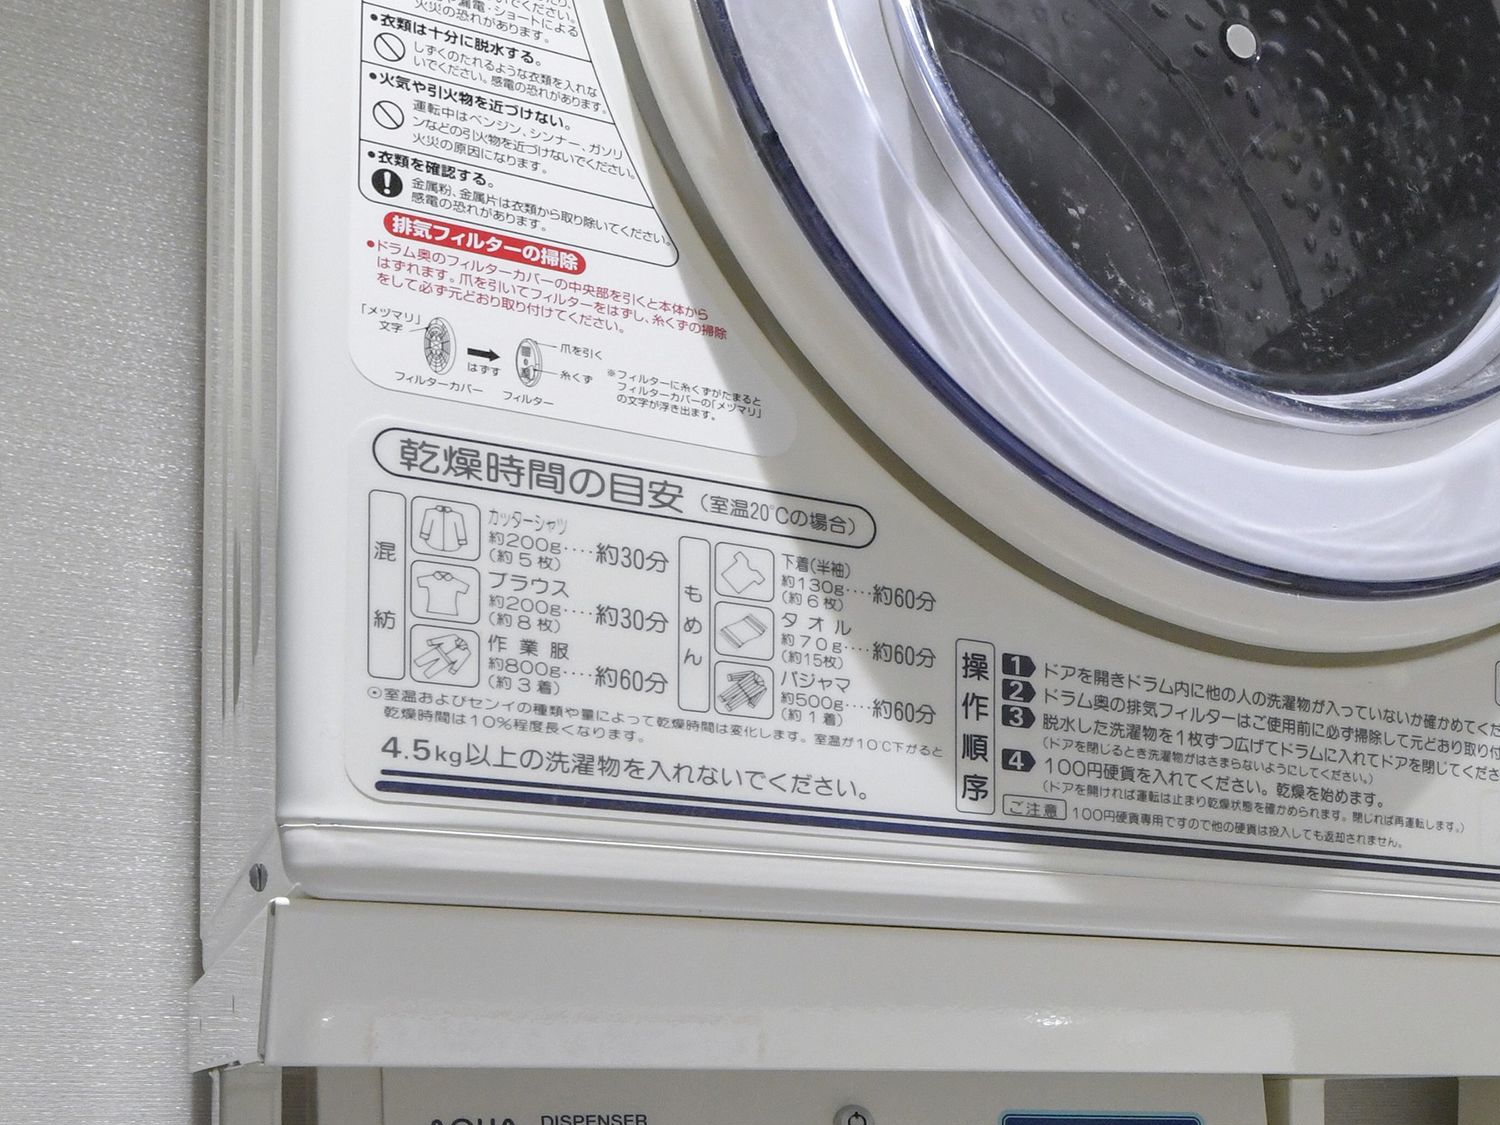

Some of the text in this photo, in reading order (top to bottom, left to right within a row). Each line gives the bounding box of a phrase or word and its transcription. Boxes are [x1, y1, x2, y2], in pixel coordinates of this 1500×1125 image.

[380, 13, 542, 67] 衣類は十分に脱水する。
[414, 41, 598, 97] しずくのたれるような衣類を入れな
[414, 57, 607, 115] いでください。感電の恐れがあります。
[379, 71, 572, 131] 火気や引火物を近づけない。
[377, 150, 495, 188] 衣類を確認する。
[412, 133, 549, 175] 火災の原因になります。
[411, 191, 548, 232] 感電の恐れがあります。
[411, 177, 672, 247] 金属粉、金属片は衣類から取り除いてください。
[391, 215, 579, 271] 排気フィルターの掃除
[376, 239, 710, 320] ドラム奥のフィルターカバーの中央部を引くと本体から
[376, 273, 625, 334] をして必ず元どおり取り付けてください。
[379, 320, 403, 333] 文字
[467, 362, 501, 377] はずす
[560, 343, 603, 360] 爪を引く
[394, 370, 483, 394] フィルターカバー
[560, 370, 594, 384] 糸くず
[502, 390, 555, 407] フィルター
[616, 394, 717, 421] の文字が浮き出ます。
[398, 437, 684, 516] 乾燥時間の目安
[488, 508, 568, 535] カッターシャツ
[488, 531, 670, 573] 約200g 約30分
[488, 571, 569, 598] ブラウス
[781, 574, 937, 612] 約130g 約60分
[488, 594, 670, 634] 約200g 約30分
[781, 612, 852, 636] タオル
[872, 642, 937, 669] 約60分
[1010, 655, 1022, 674] 1
[488, 657, 669, 695] 約800g 約60分
[781, 670, 851, 693] パジャマ
[1009, 681, 1025, 701] 2
[781, 691, 937, 725] 約500g 約60分
[962, 651, 989, 802] 操作順序
[1009, 706, 1025, 727] 3
[381, 736, 869, 801] 4.5kg以上の洗濯物を入れないでください。
[1008, 751, 1384, 808] 4 100円硬貨を入れてください。乾燥を始めます。
[1009, 800, 1058, 818] ご注意
